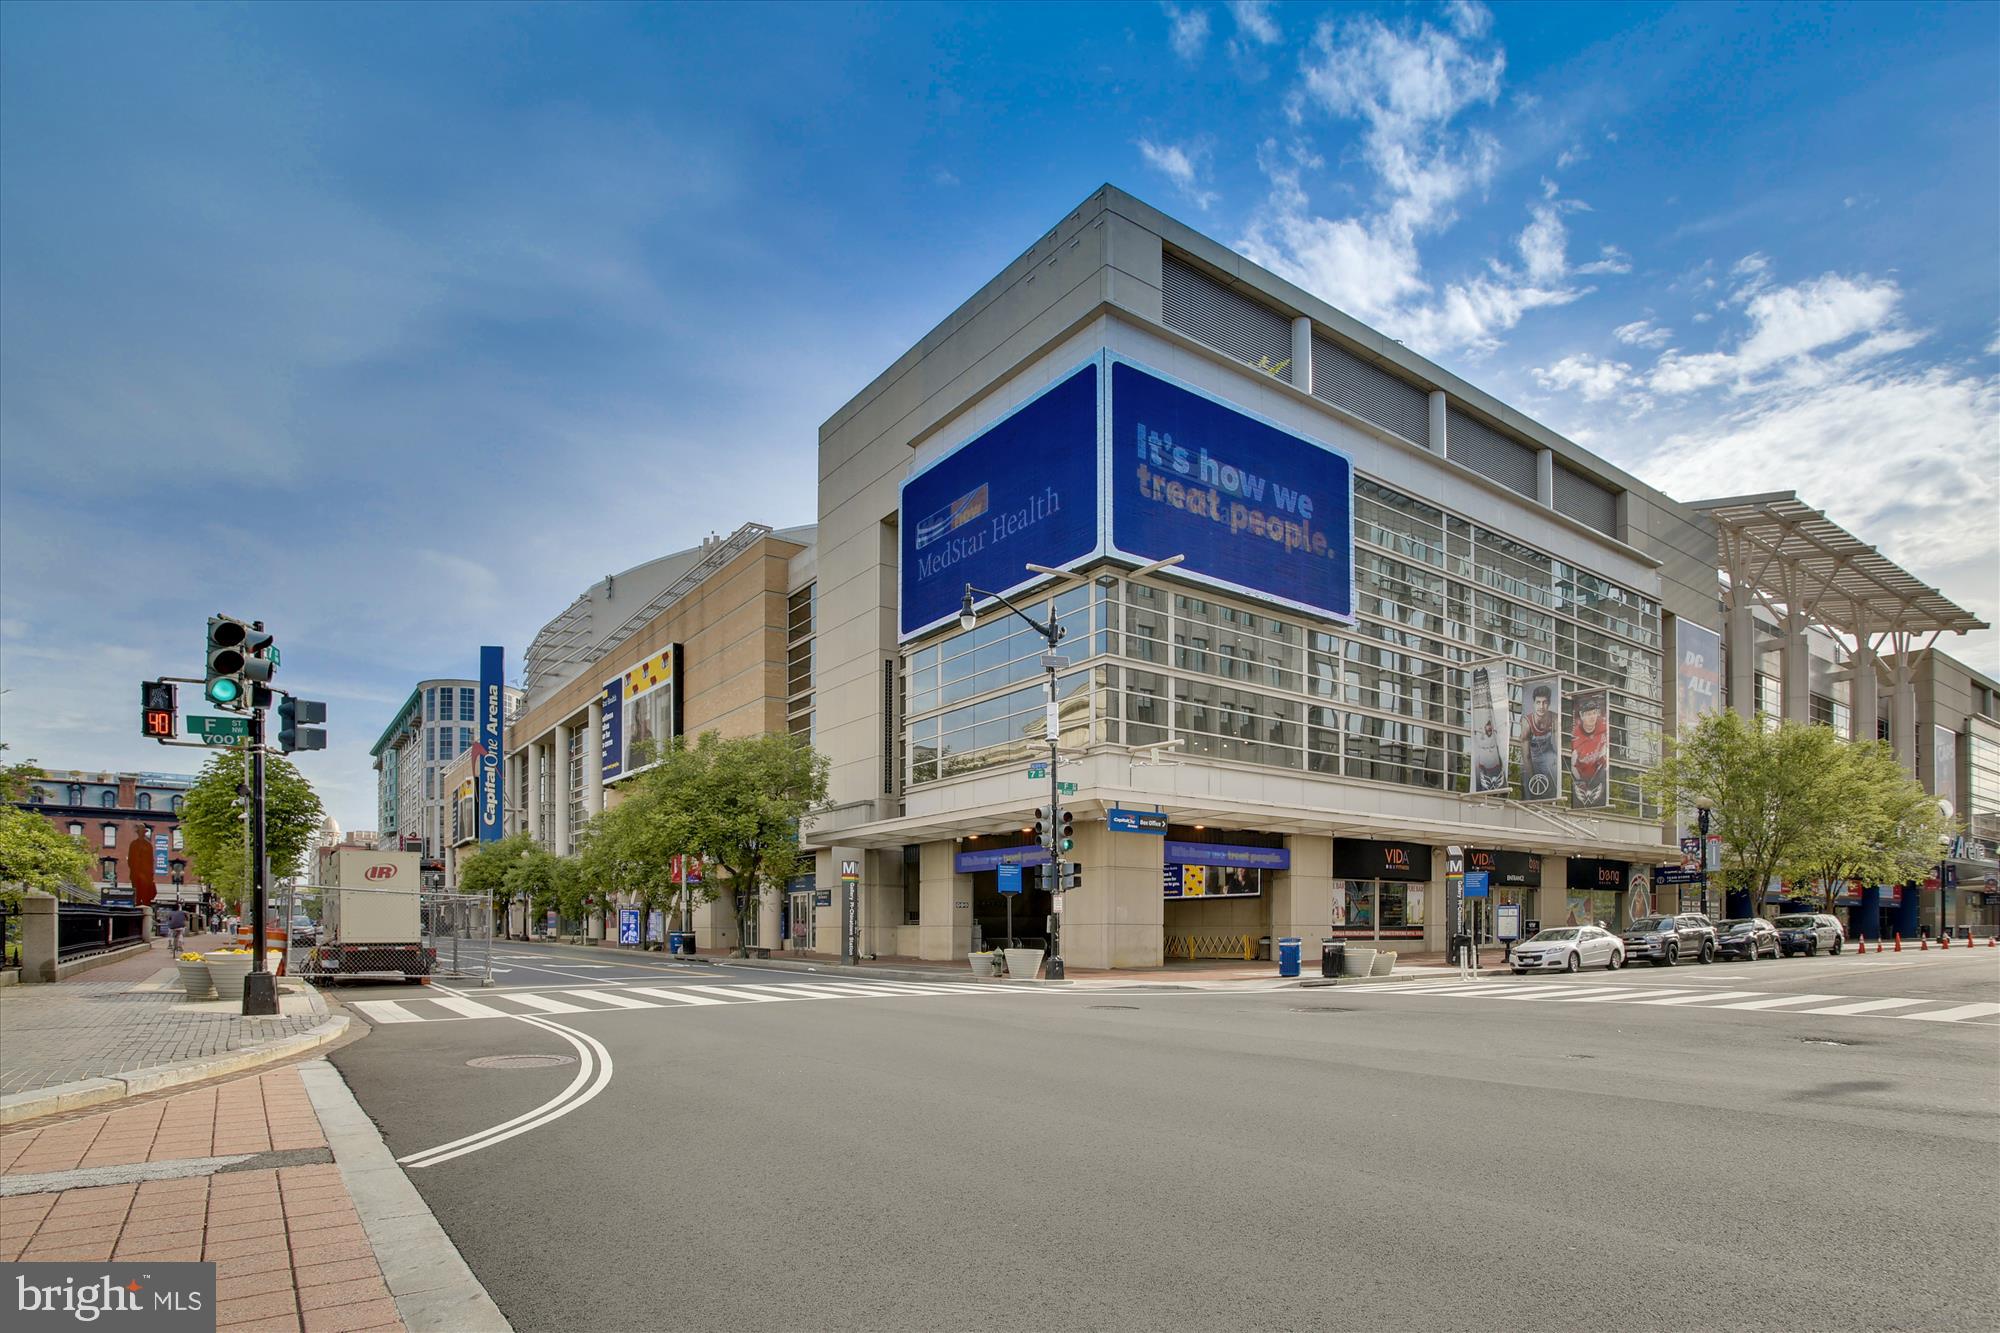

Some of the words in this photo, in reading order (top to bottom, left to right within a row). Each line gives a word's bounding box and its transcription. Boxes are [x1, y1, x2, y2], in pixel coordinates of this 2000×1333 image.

[1137, 423, 1190, 474] It's
[1200, 448, 1266, 502] how
[1272, 483, 1314, 530] we
[1136, 463, 1220, 522] treat
[917, 530, 987, 582] MedStar
[991, 486, 1061, 545] Health
[1685, 649, 1704, 668] DC
[1688, 676, 1713, 697] ALL
[486, 685, 499, 736] Arena
[148, 713, 169, 735] 40
[204, 718, 217, 732] F
[203, 734, 235, 745] 700
[1384, 848, 1409, 864] VIDA
[1471, 853, 1496, 866] VIDA
[370, 866, 393, 879] IR
[842, 861, 855, 874] M
[1449, 860, 1463, 872] M
[1598, 866, 1620, 885] bang
